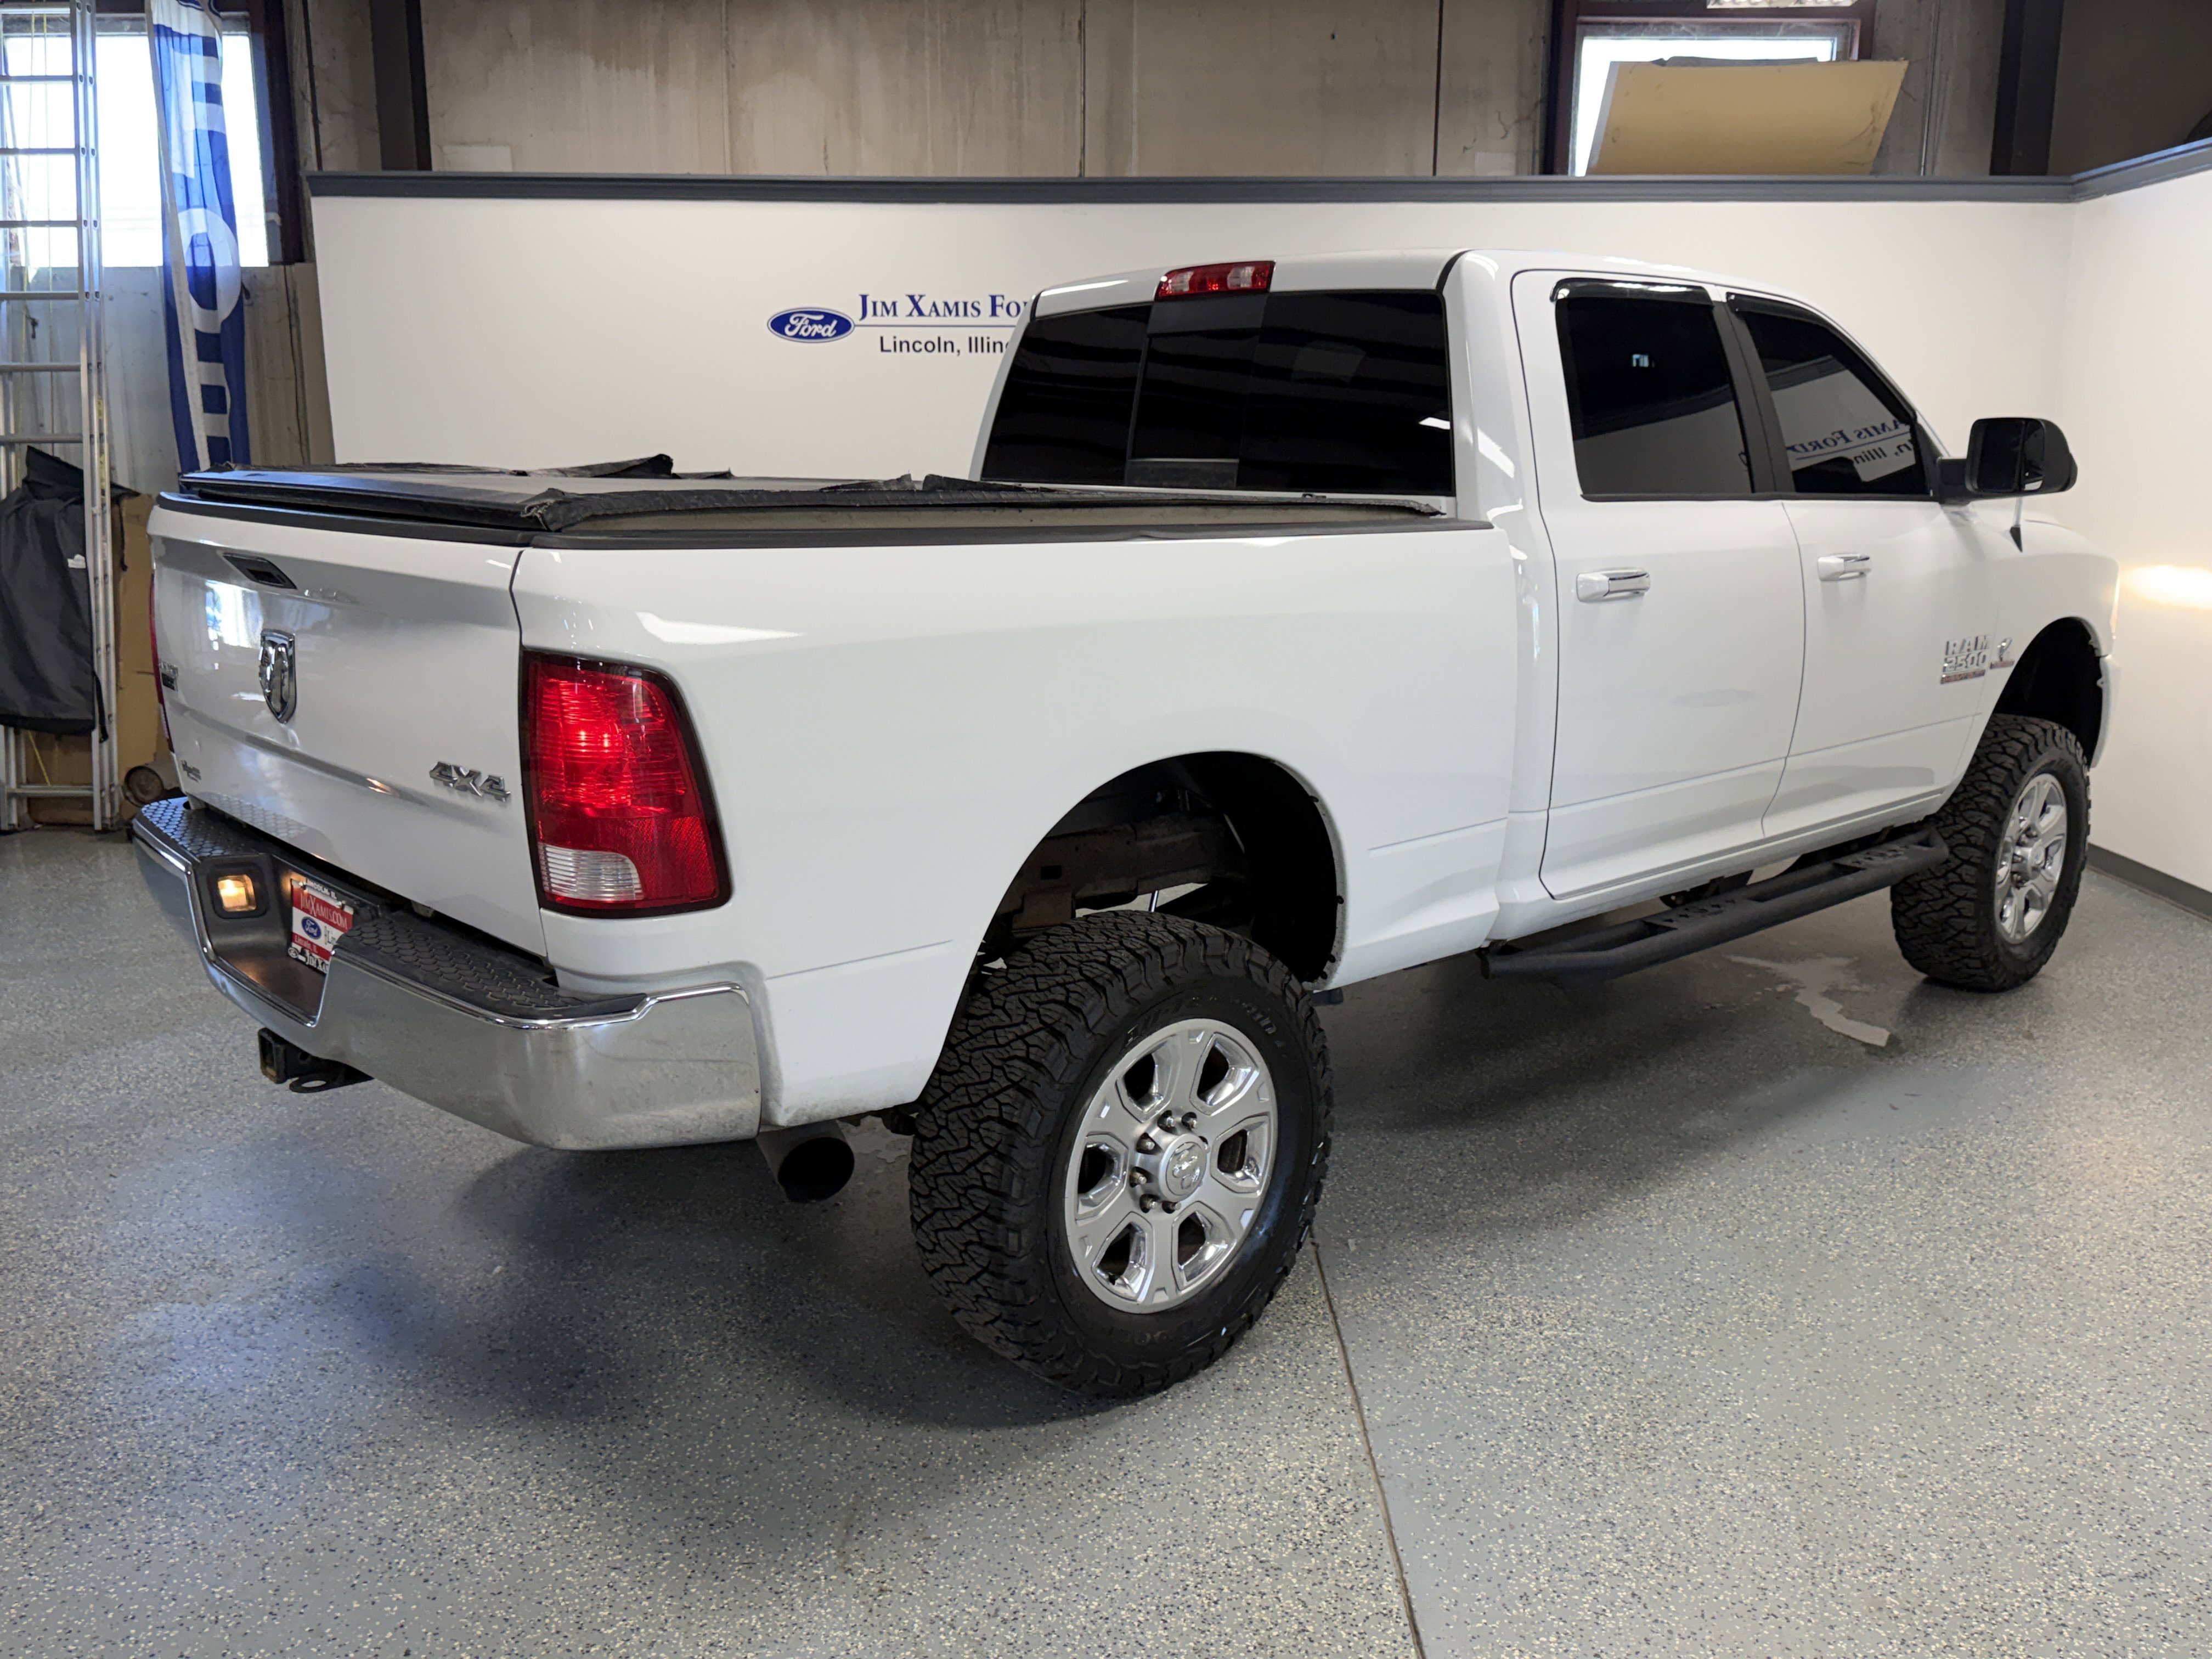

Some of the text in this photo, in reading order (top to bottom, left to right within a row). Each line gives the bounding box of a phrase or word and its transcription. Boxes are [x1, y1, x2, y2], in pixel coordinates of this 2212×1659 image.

[858, 294, 1028, 321] JIM XAMIS FO
[783, 311, 837, 338] Ford
[880, 336, 1008, 356] Lincoln, Illin
